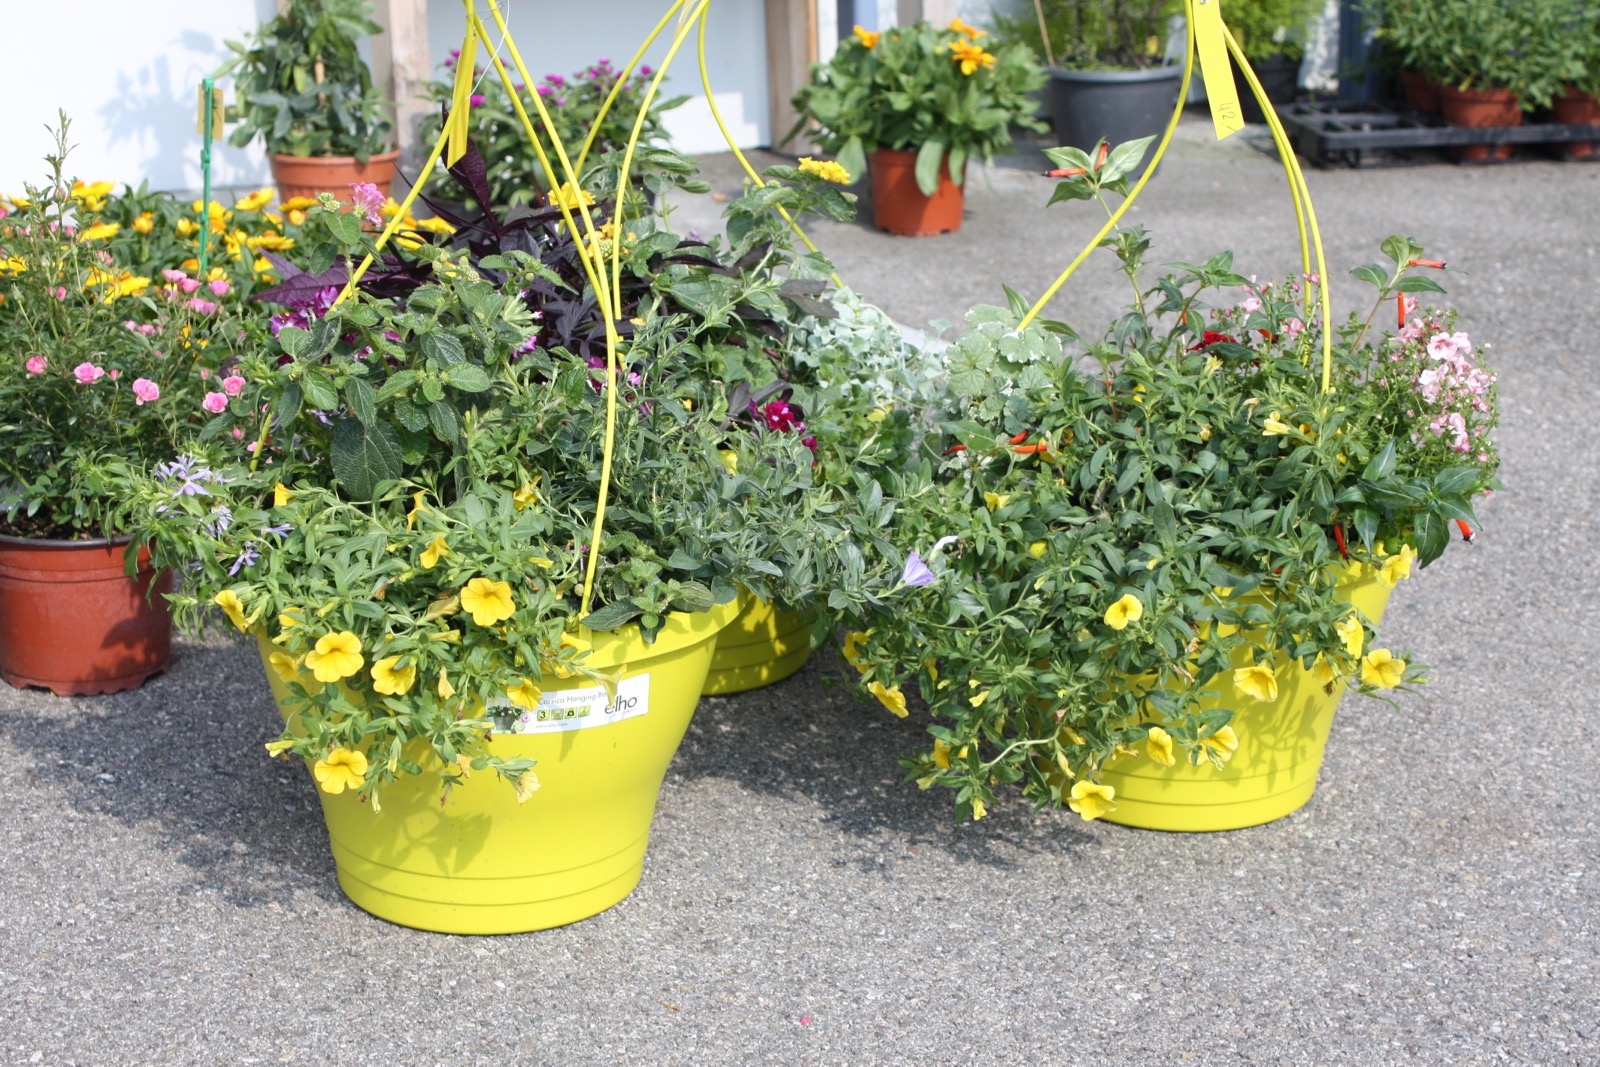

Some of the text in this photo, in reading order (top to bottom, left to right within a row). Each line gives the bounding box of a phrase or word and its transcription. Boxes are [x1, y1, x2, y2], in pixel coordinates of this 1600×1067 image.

[538, 697, 565, 706] Corsica
[567, 694, 596, 703] Hanging
[604, 695, 638, 714] elho
